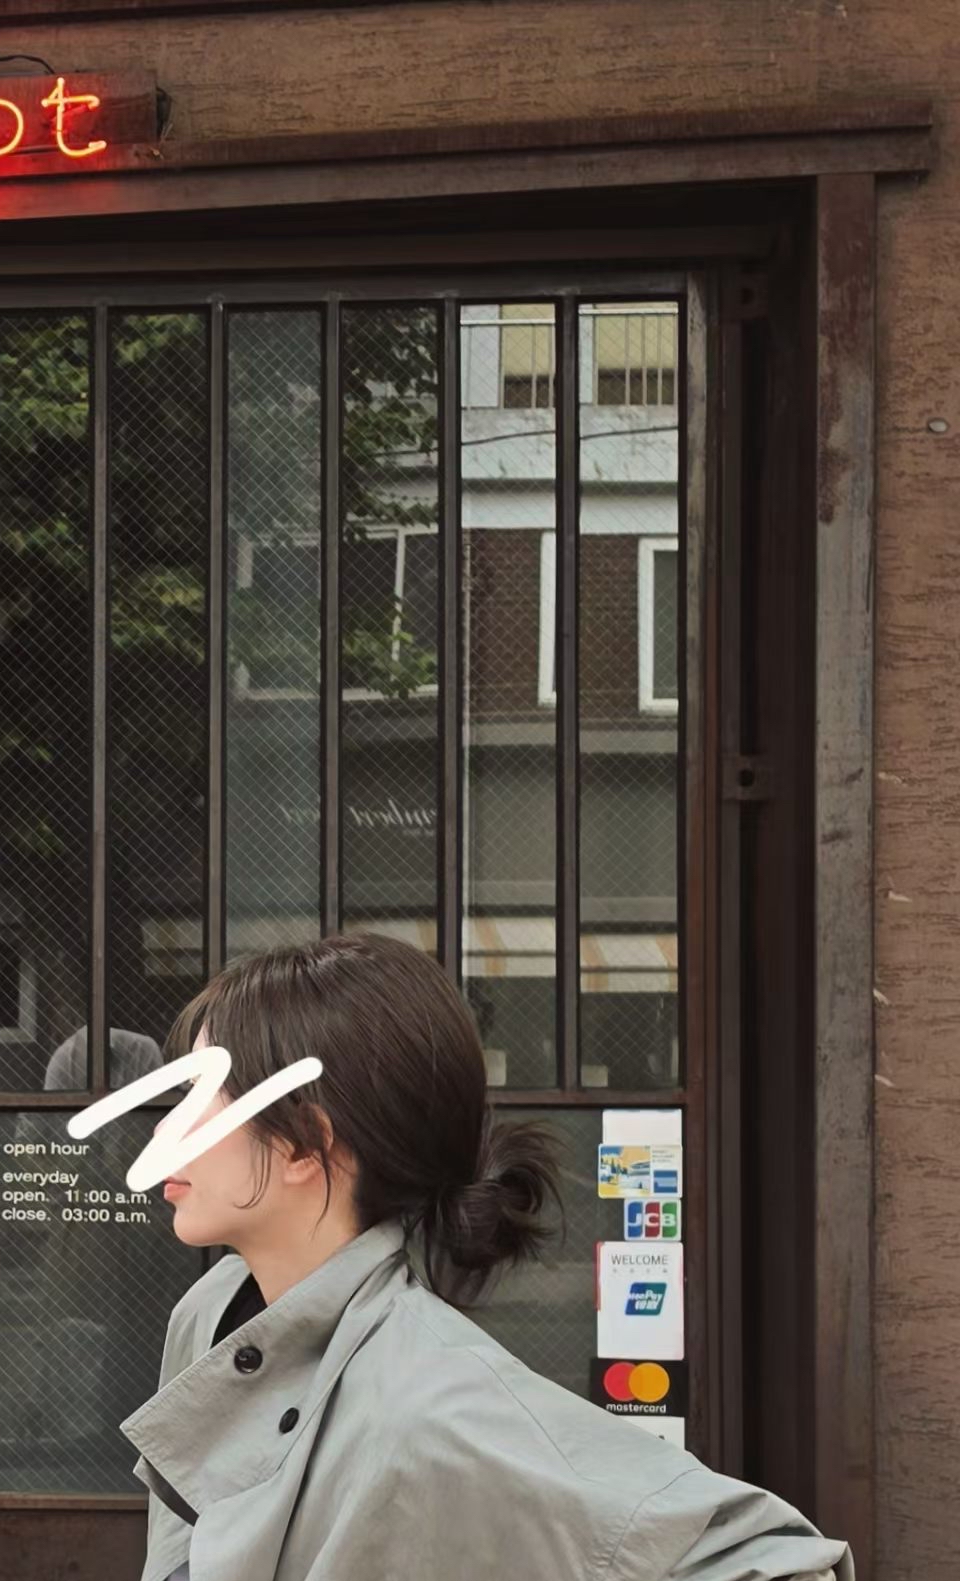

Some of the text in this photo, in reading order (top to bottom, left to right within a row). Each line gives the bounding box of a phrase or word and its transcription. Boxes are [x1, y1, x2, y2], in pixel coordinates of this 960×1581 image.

[3, 1141, 90, 1157] open hour
[2, 1170, 79, 1187] everyday
[2, 1190, 50, 1204] open.
[114, 1192, 152, 1205] a.m.
[1, 1207, 151, 1224] close. 03:00 a.m.
[611, 1254, 669, 1265] WELCOME
[606, 1403, 667, 1413] mastercard
